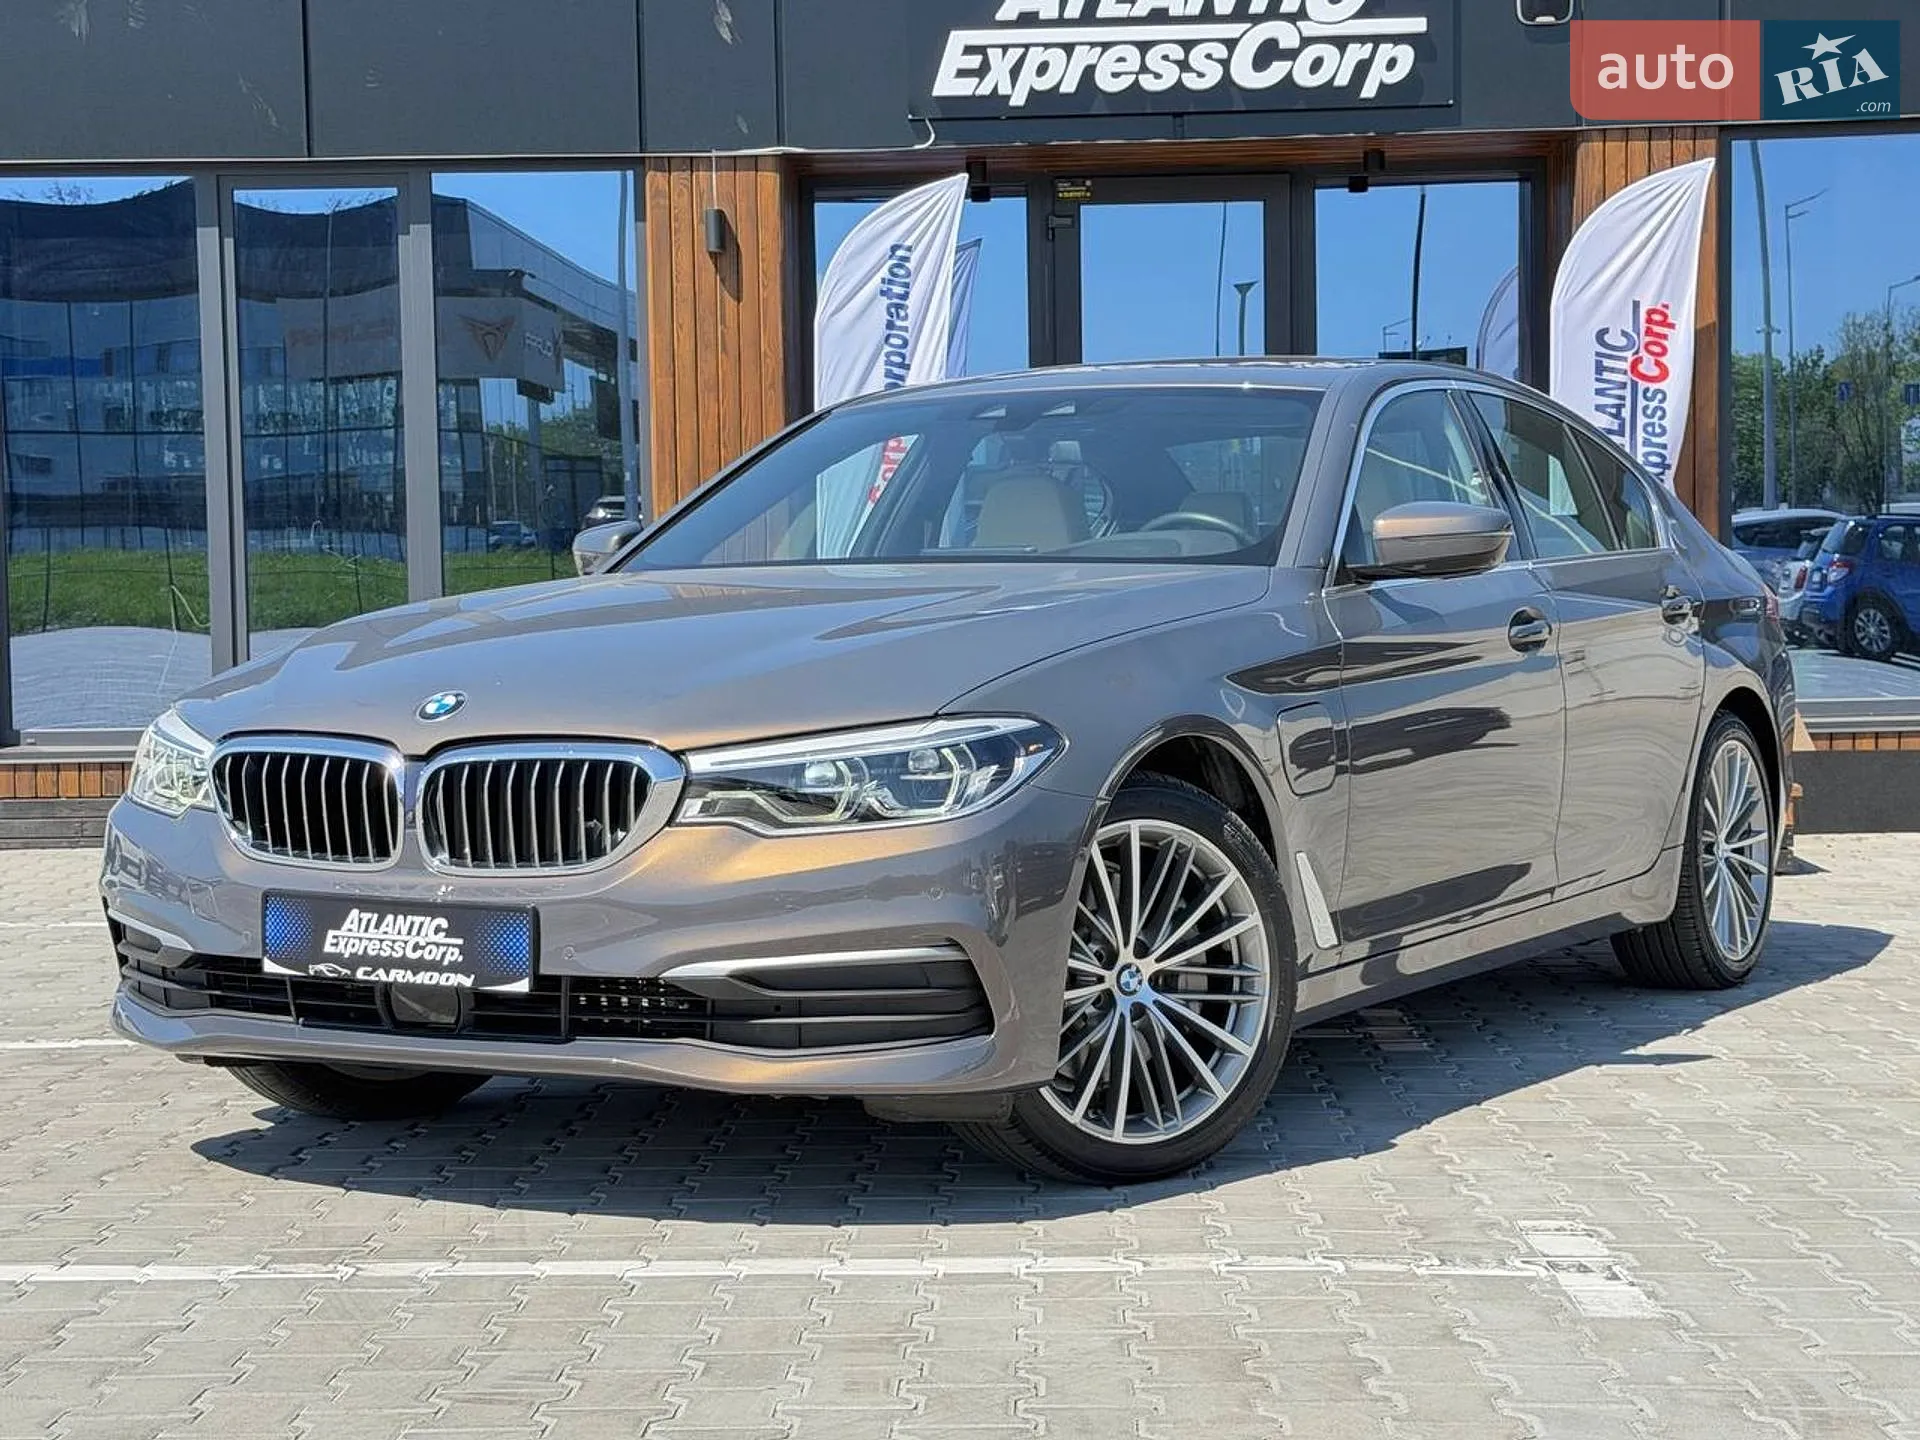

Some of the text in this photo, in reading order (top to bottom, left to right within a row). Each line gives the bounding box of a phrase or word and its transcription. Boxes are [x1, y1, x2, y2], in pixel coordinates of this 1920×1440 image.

[931, 21, 1414, 107] ExpressCorp
[1594, 327, 1637, 447] LANTIC
[341, 908, 449, 940] ATLANTIC
[323, 930, 464, 966] ExpressCorp.
[356, 967, 475, 988] CARMOON
